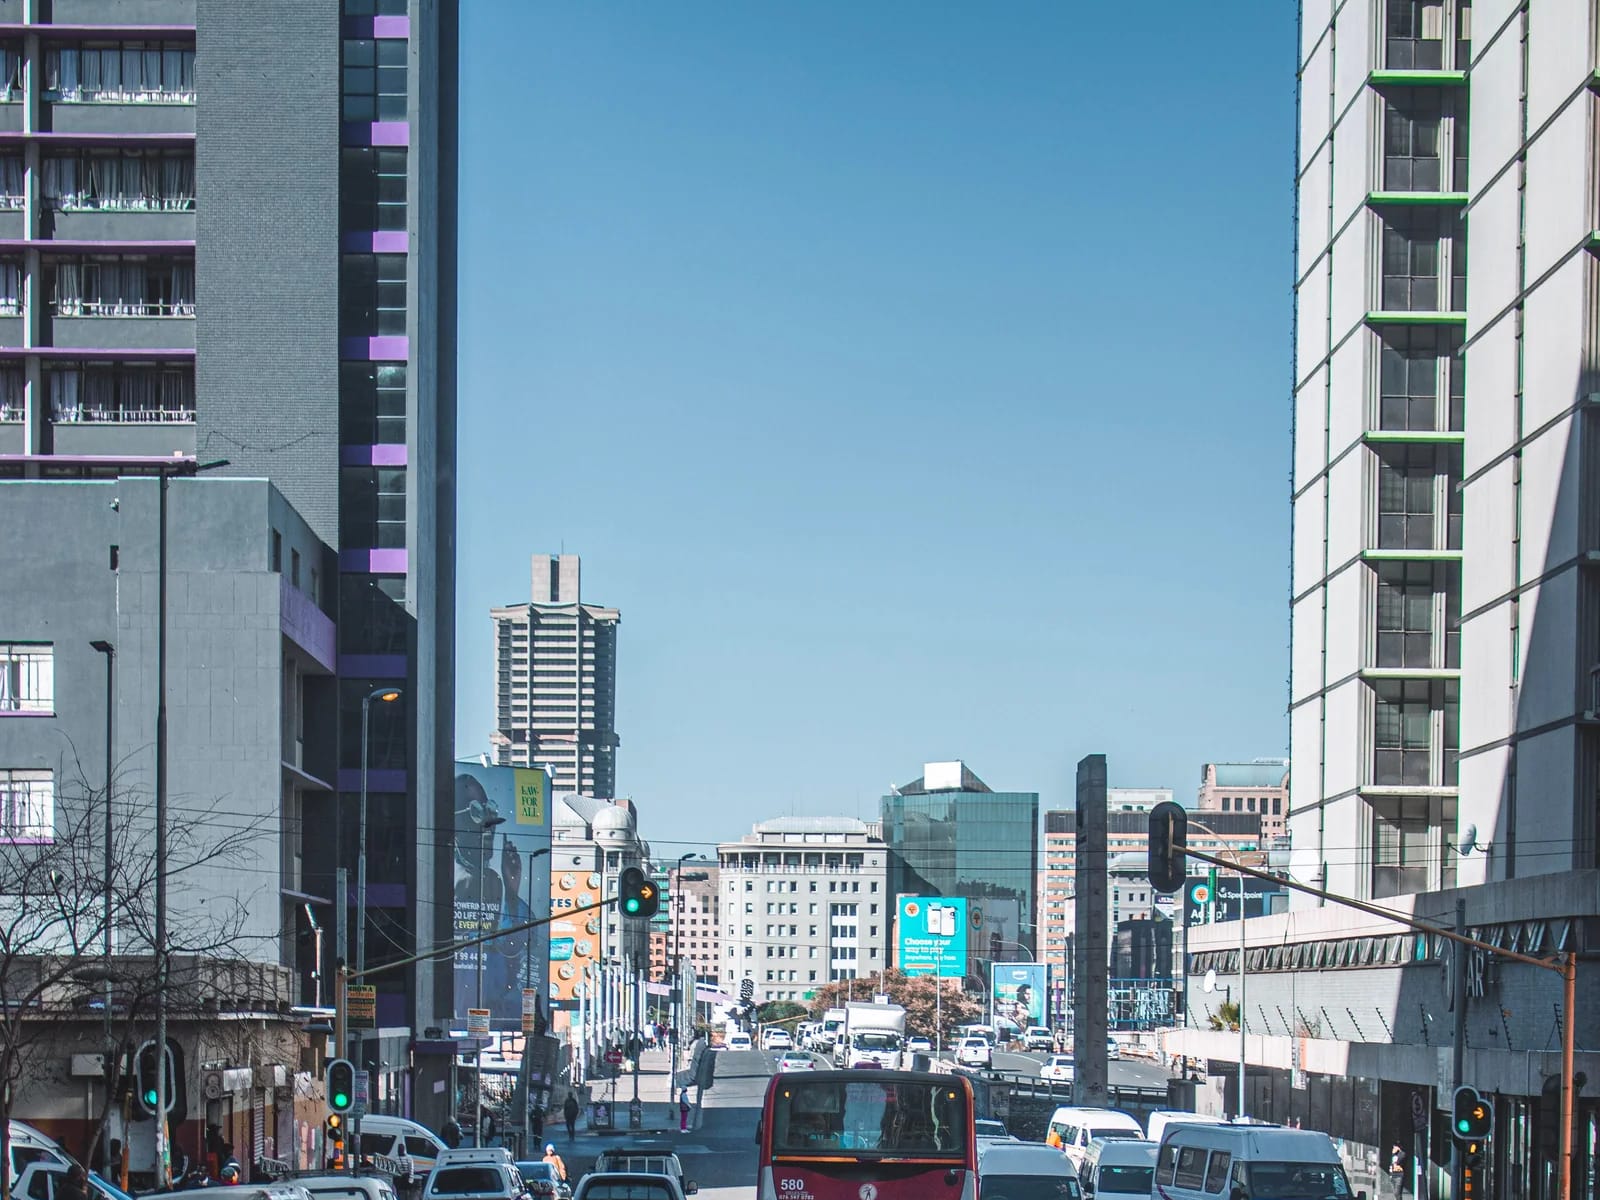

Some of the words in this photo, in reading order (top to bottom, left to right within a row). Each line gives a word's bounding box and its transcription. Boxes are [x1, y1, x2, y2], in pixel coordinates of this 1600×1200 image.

[522, 797, 537, 806] FOR
[522, 808, 538, 817] ALL
[487, 903, 500, 911] YOU
[463, 911, 476, 919] LIFE
[781, 1179, 804, 1191] 580
